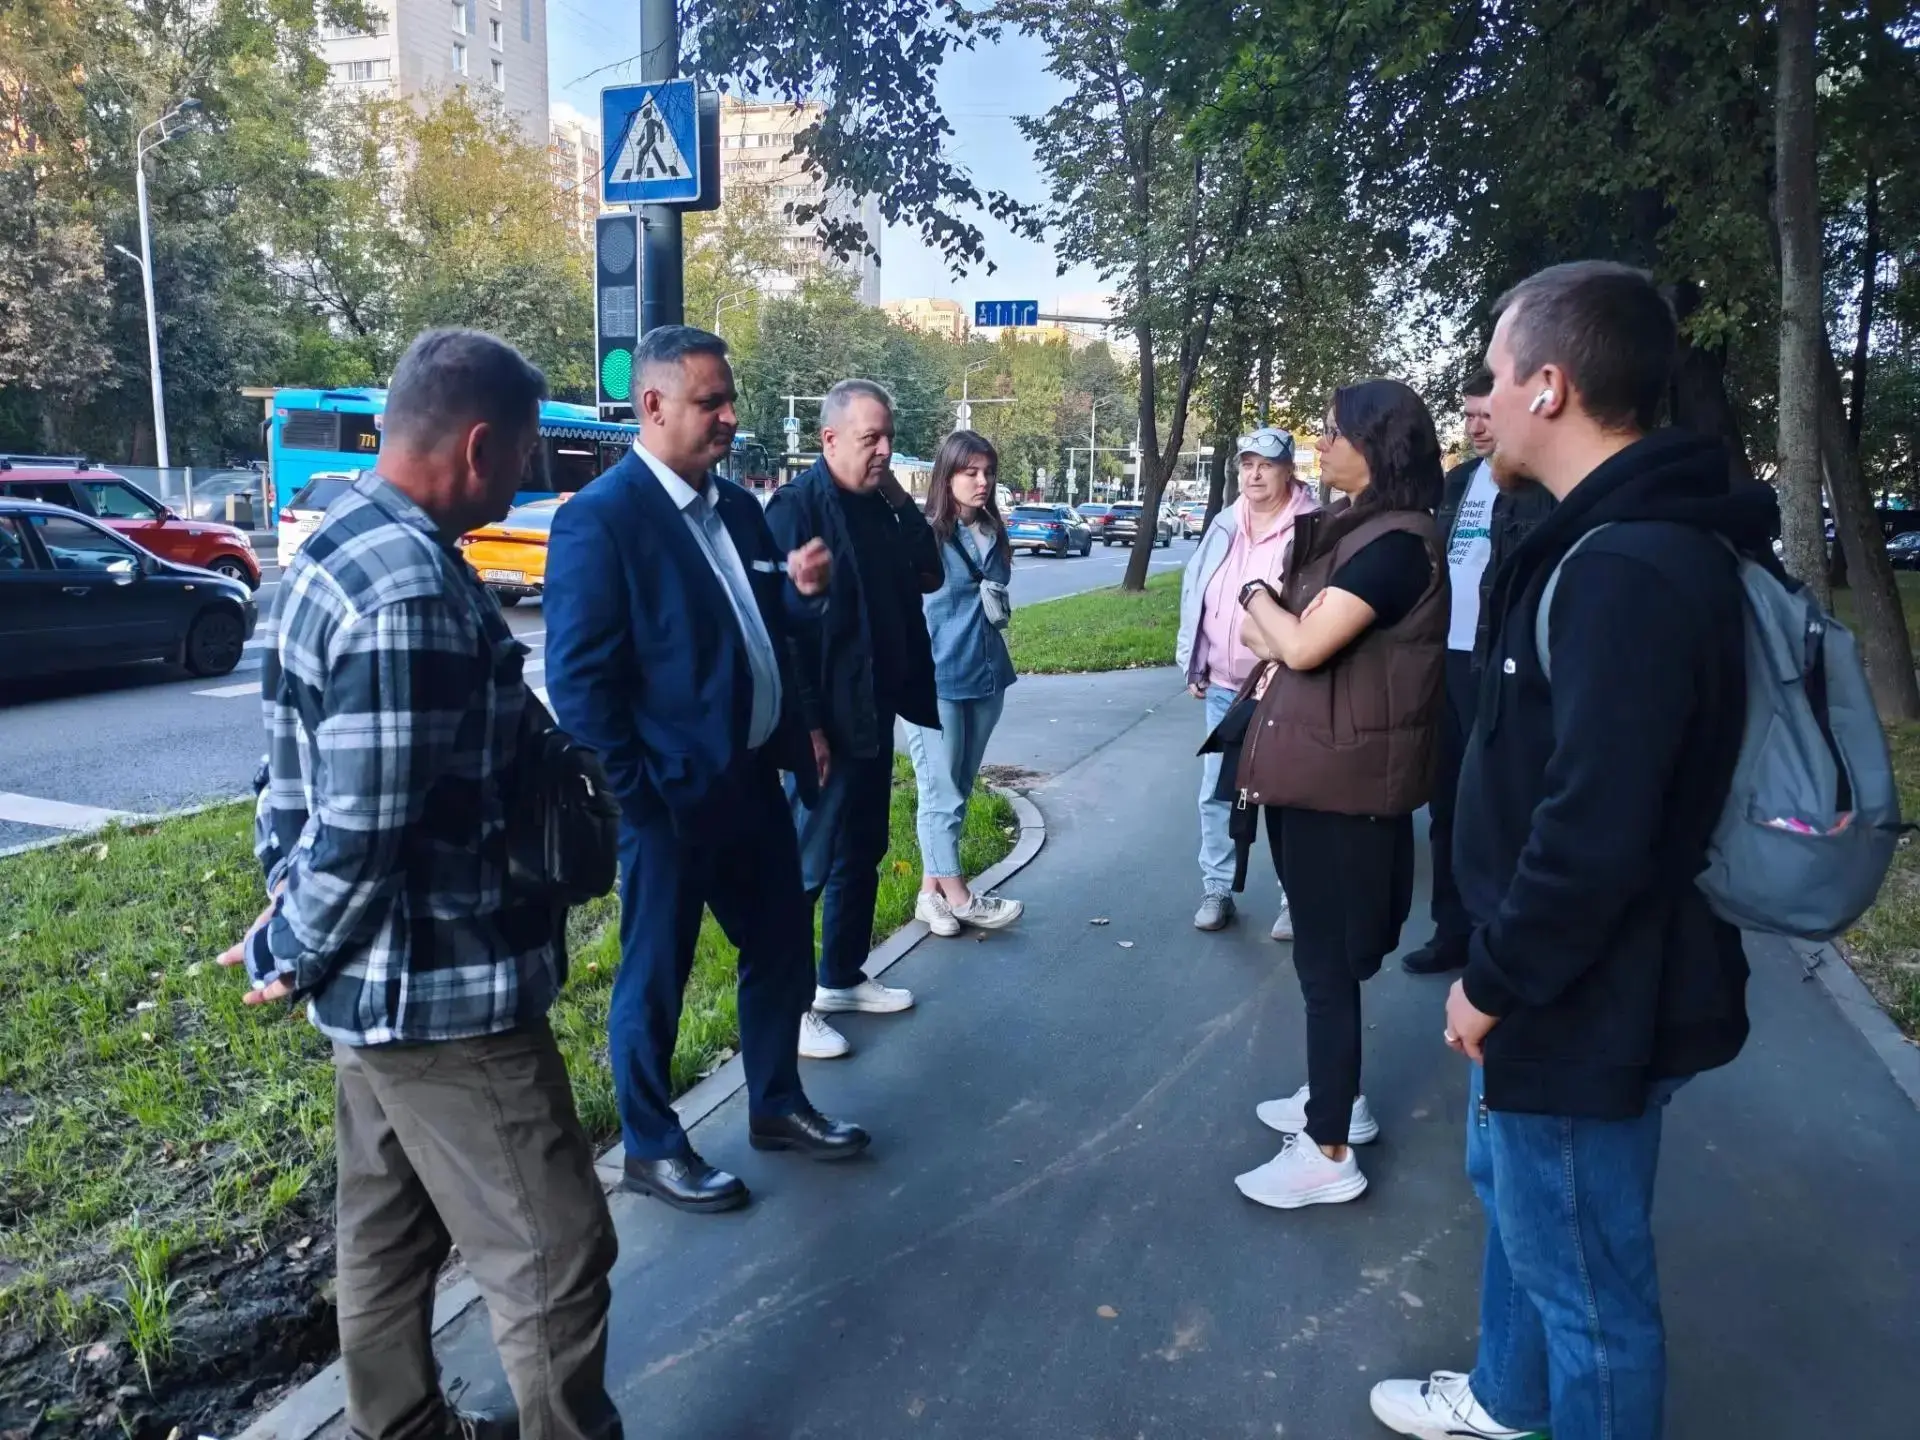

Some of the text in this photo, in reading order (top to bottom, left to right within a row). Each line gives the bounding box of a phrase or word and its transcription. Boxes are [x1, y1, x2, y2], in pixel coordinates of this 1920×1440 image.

[359, 433, 376, 447] 771
[1461, 500, 1486, 508] ОВЫЕ
[1459, 510, 1483, 518] ОВЫЕ
[1456, 519, 1480, 528] ОВЫЕ
